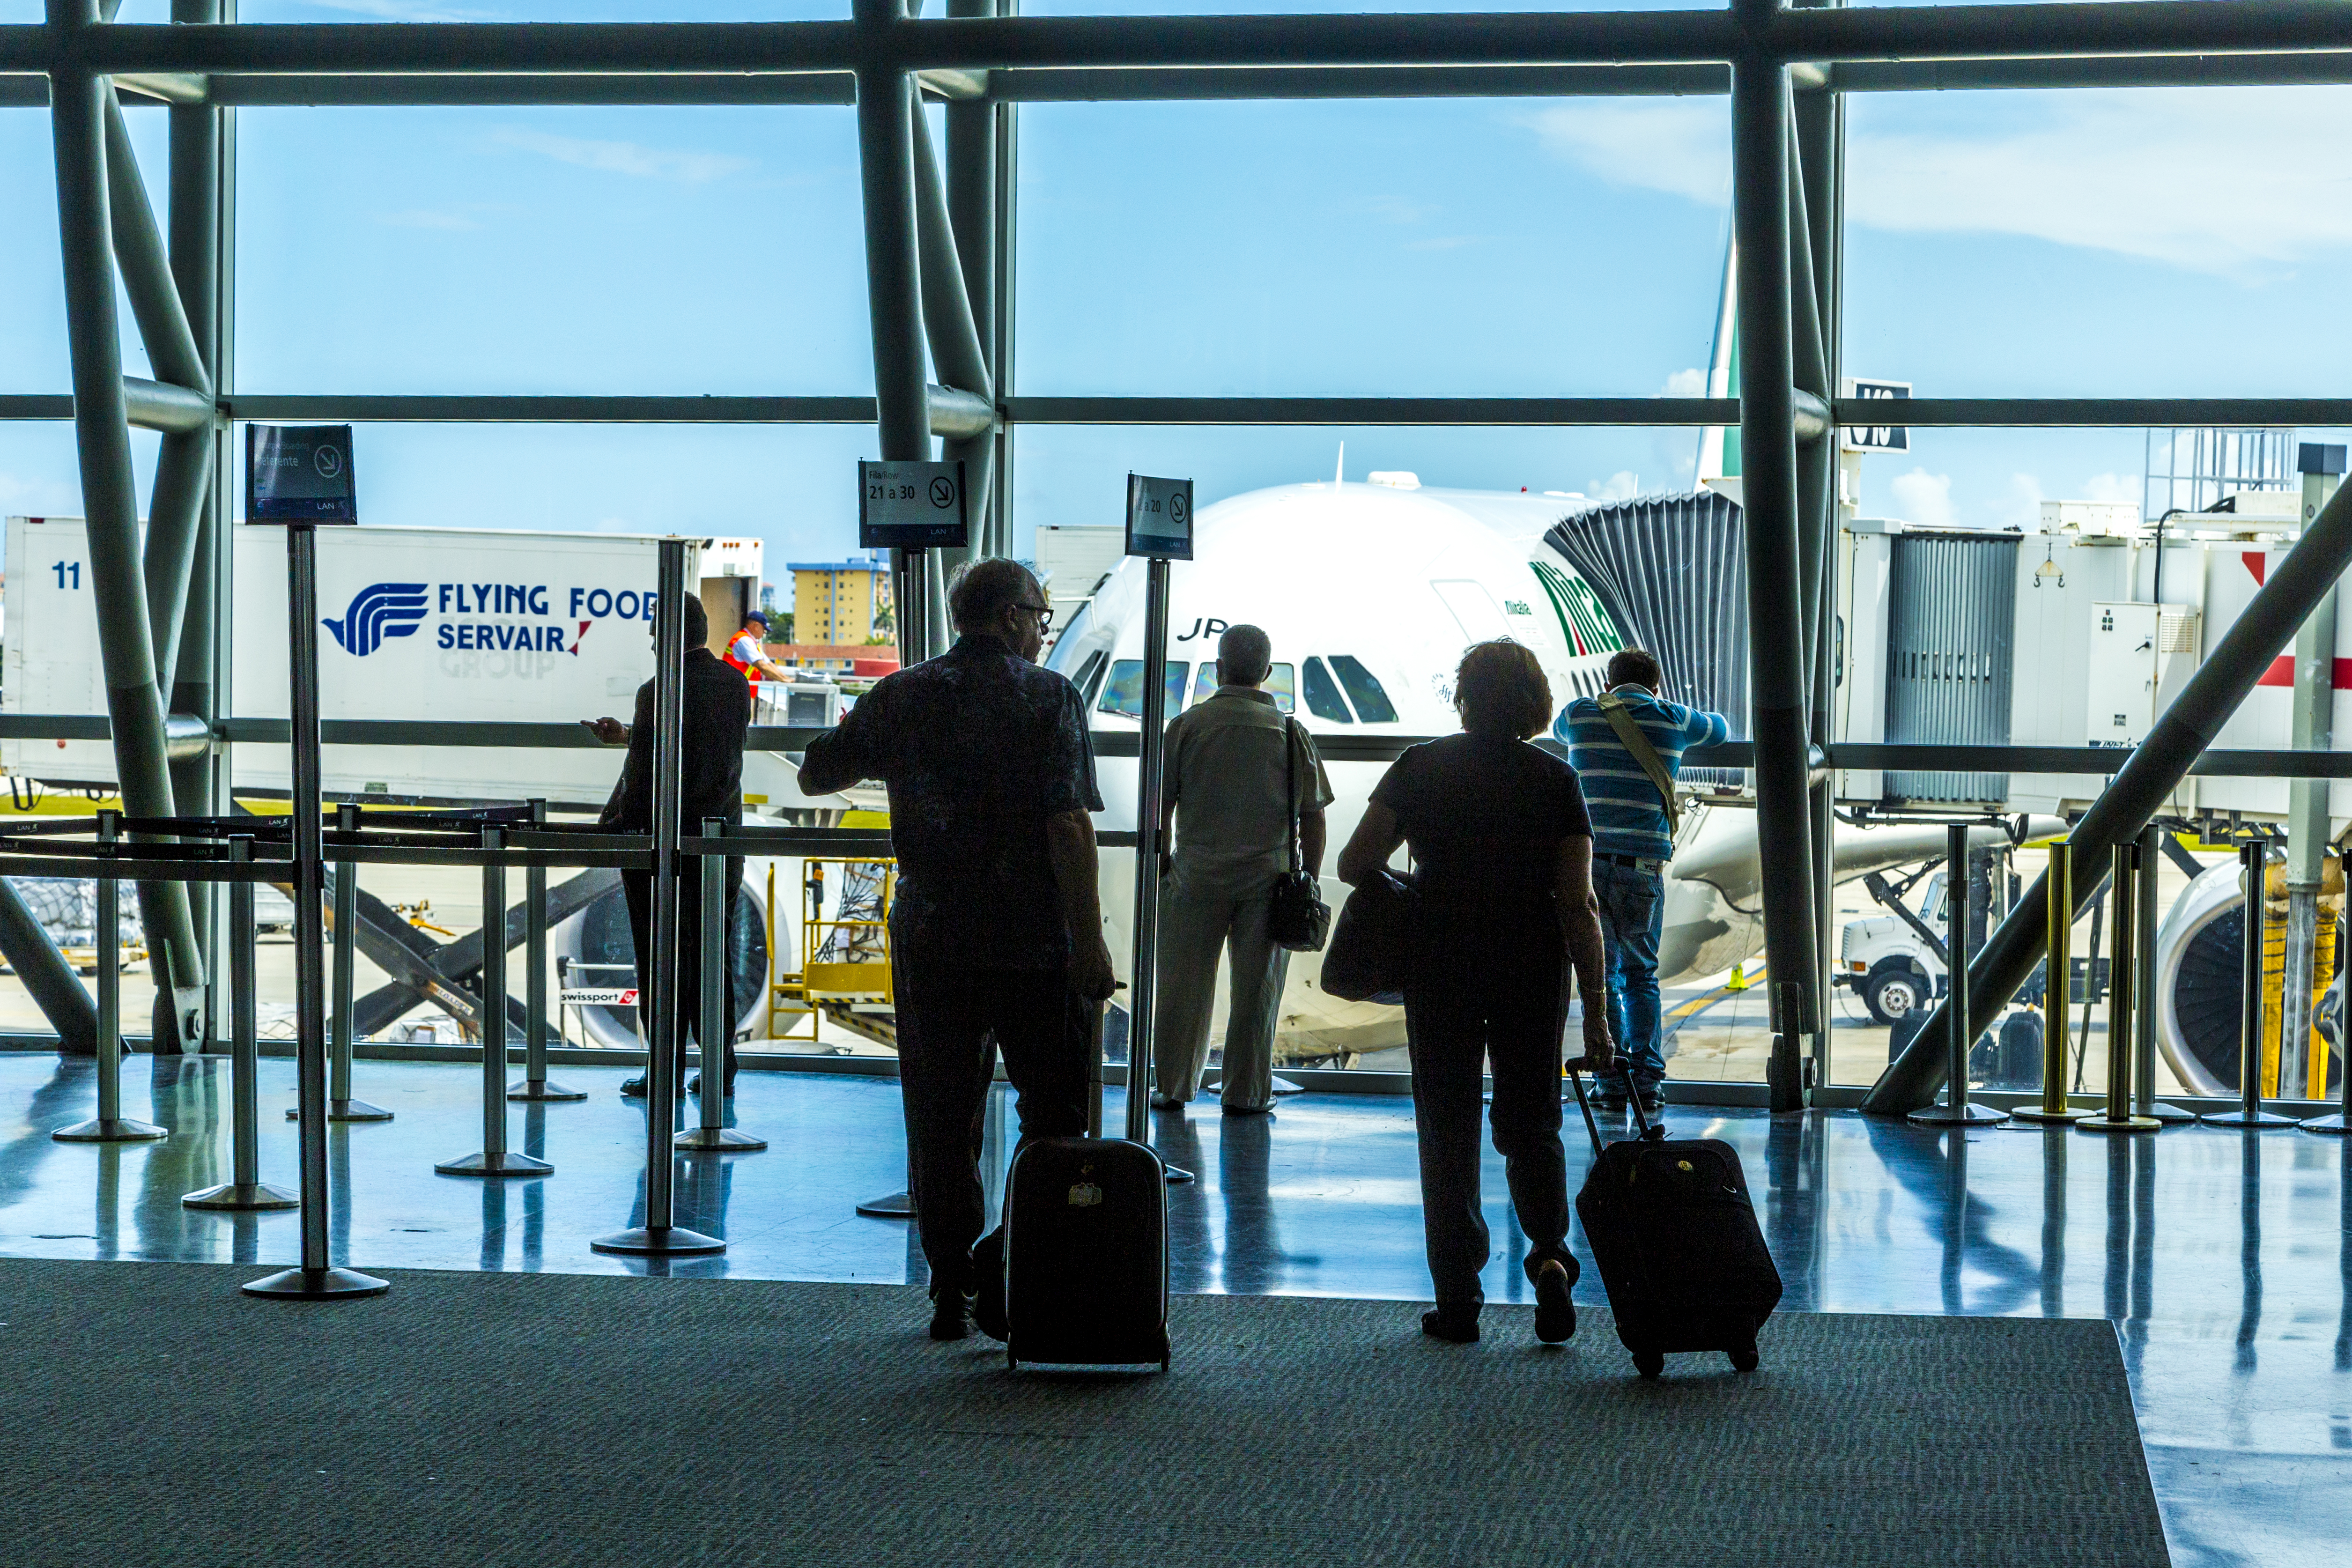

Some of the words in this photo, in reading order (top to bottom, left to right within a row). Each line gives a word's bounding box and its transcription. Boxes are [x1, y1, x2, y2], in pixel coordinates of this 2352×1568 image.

[870, 485, 884, 500] 21
[889, 488, 895, 499] a
[900, 485, 915, 500] 30
[1144, 502, 1149, 511] a
[1151, 499, 1161, 513] 20
[52, 561, 79, 590] 11
[438, 584, 548, 615] FLYING
[437, 623, 565, 652] SERVAIR
[561, 992, 618, 1003] swissport
